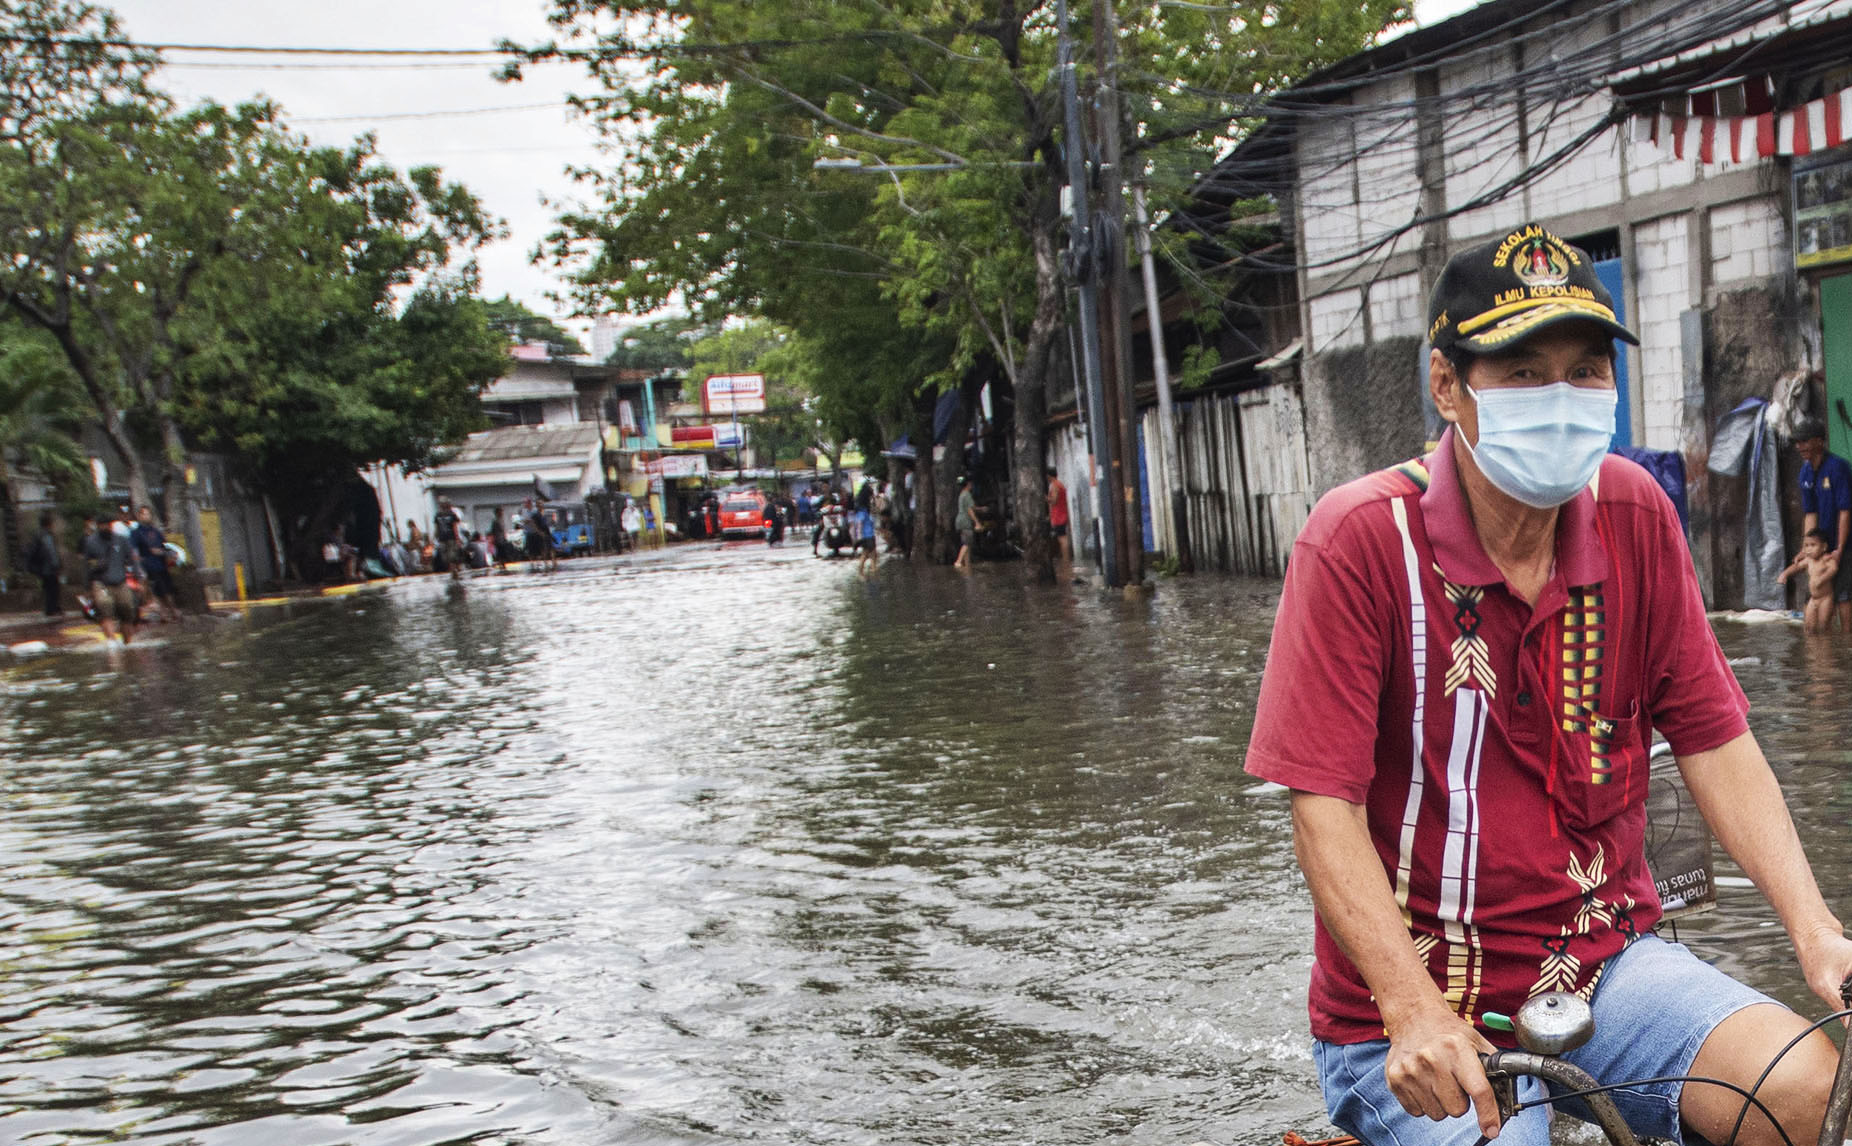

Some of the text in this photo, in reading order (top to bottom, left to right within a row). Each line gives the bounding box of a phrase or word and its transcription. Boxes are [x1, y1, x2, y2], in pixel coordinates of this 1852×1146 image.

[1493, 225, 1581, 267] SEKOLAH TINGGI
[1494, 284, 1595, 306] ILMU KEPOLISIAN
[1671, 868, 1706, 888] tunas
